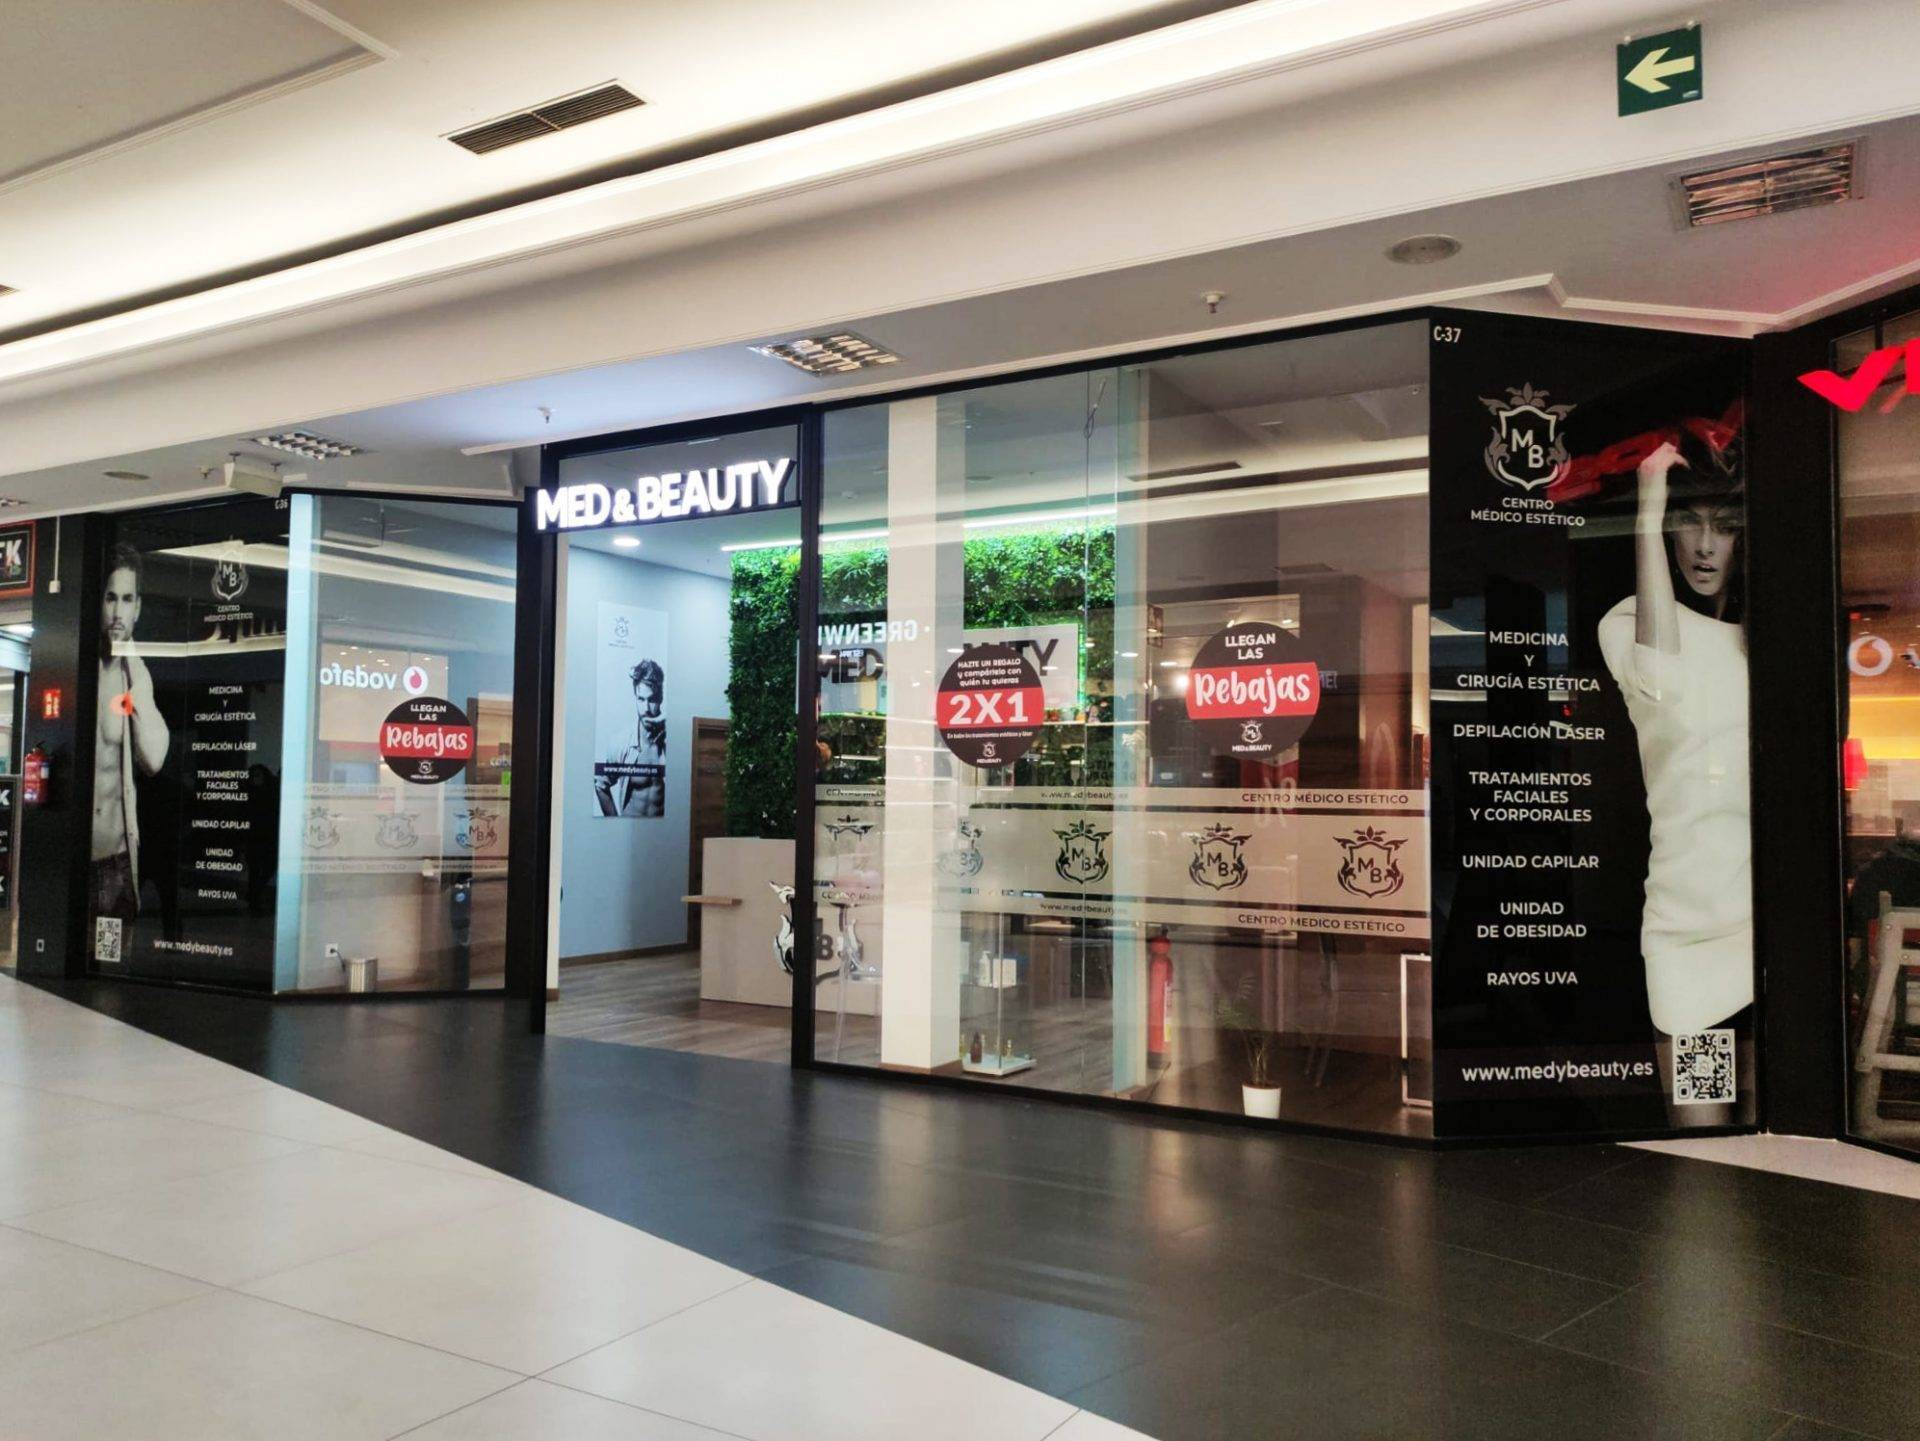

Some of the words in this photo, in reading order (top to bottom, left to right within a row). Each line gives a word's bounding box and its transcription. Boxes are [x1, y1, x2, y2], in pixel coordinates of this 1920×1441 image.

[1433, 326, 1462, 344] C-37
[1502, 497, 1554, 511] CENTRO
[1471, 508, 1522, 523] MÉDICO
[1526, 511, 1586, 527] ESTÉTICO
[1225, 633, 1276, 647] LLEGAN
[1489, 631, 1569, 647] MEDICINA
[1238, 648, 1264, 660] LAS
[993, 658, 1021, 666] REGALO
[1524, 655, 1535, 667] Y
[1457, 673, 1523, 689] CIRUGÍA
[1528, 674, 1600, 692] ESTÉTICA
[209, 686, 243, 695] MEDICINA
[1195, 667, 1311, 715] Rebajas
[223, 699, 228, 708] Y
[410, 704, 447, 713] LLEGAN
[949, 691, 1029, 725] 2X1
[195, 712, 222, 722] CIRUGÍA
[224, 711, 256, 721] ESTÉTICA
[419, 713, 438, 721] LAS
[1453, 722, 1551, 739] DEPILACIÓN
[1555, 724, 1605, 741] LÁSER
[192, 741, 233, 751] DEPILACIÓN
[235, 740, 257, 751] LÁSER
[386, 726, 468, 757] Rebajas
[197, 770, 249, 779] TRATAMIENTOS
[1469, 771, 1592, 786] TRATAMIENTOS
[206, 781, 239, 790] FACIALES
[197, 792, 202, 800] Y
[202, 792, 249, 801] CORPORALES
[1242, 793, 1291, 803] CENTRO
[1493, 790, 1569, 804] FACIALES
[1470, 808, 1480, 821] Y
[1484, 808, 1592, 822] CORPORALES
[192, 819, 220, 829] UNIDAD
[220, 820, 250, 830] CAPILAR
[206, 848, 233, 858] UNIDAD
[196, 861, 206, 870] DE
[206, 862, 243, 872] OBESIDAD
[1462, 855, 1527, 869] UNIDAD
[1531, 855, 1599, 869] CAPILAR
[198, 889, 221, 899] RAYOS
[222, 890, 237, 900] UVA
[1500, 902, 1564, 915] UNIDAD
[1238, 914, 1287, 926] CENTRO
[1477, 925, 1499, 938] DE
[1503, 924, 1587, 938] OBESIDAD
[1487, 972, 1540, 985] RAYOS
[1545, 972, 1578, 985] UVA
[1462, 1061, 1654, 1083] www.medybeauty.es
